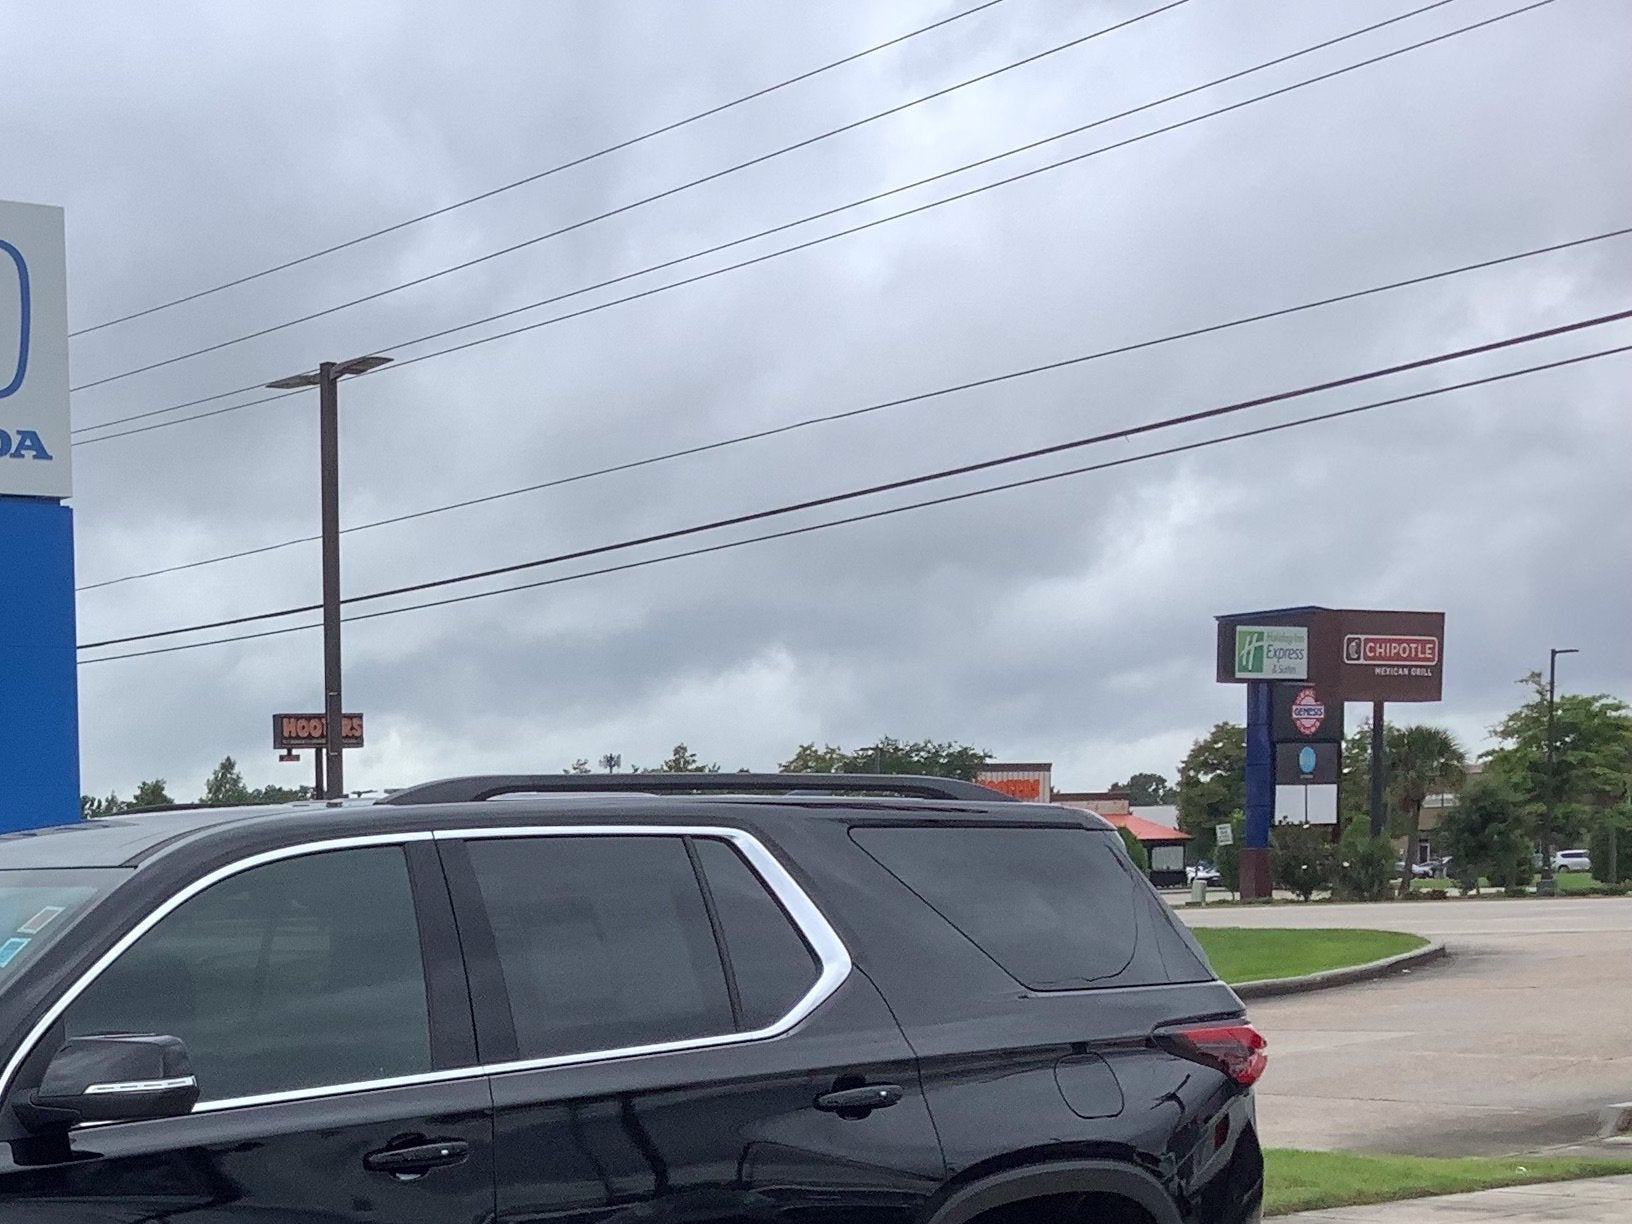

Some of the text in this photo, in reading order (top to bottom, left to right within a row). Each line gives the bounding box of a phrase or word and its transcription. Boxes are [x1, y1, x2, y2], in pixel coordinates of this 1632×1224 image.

[1266, 644, 1305, 662] Express
[1365, 642, 1434, 658] CHIPOTLE
[1375, 666, 1432, 677] MEXICAN GRILL
[282, 717, 362, 738] HOORS
